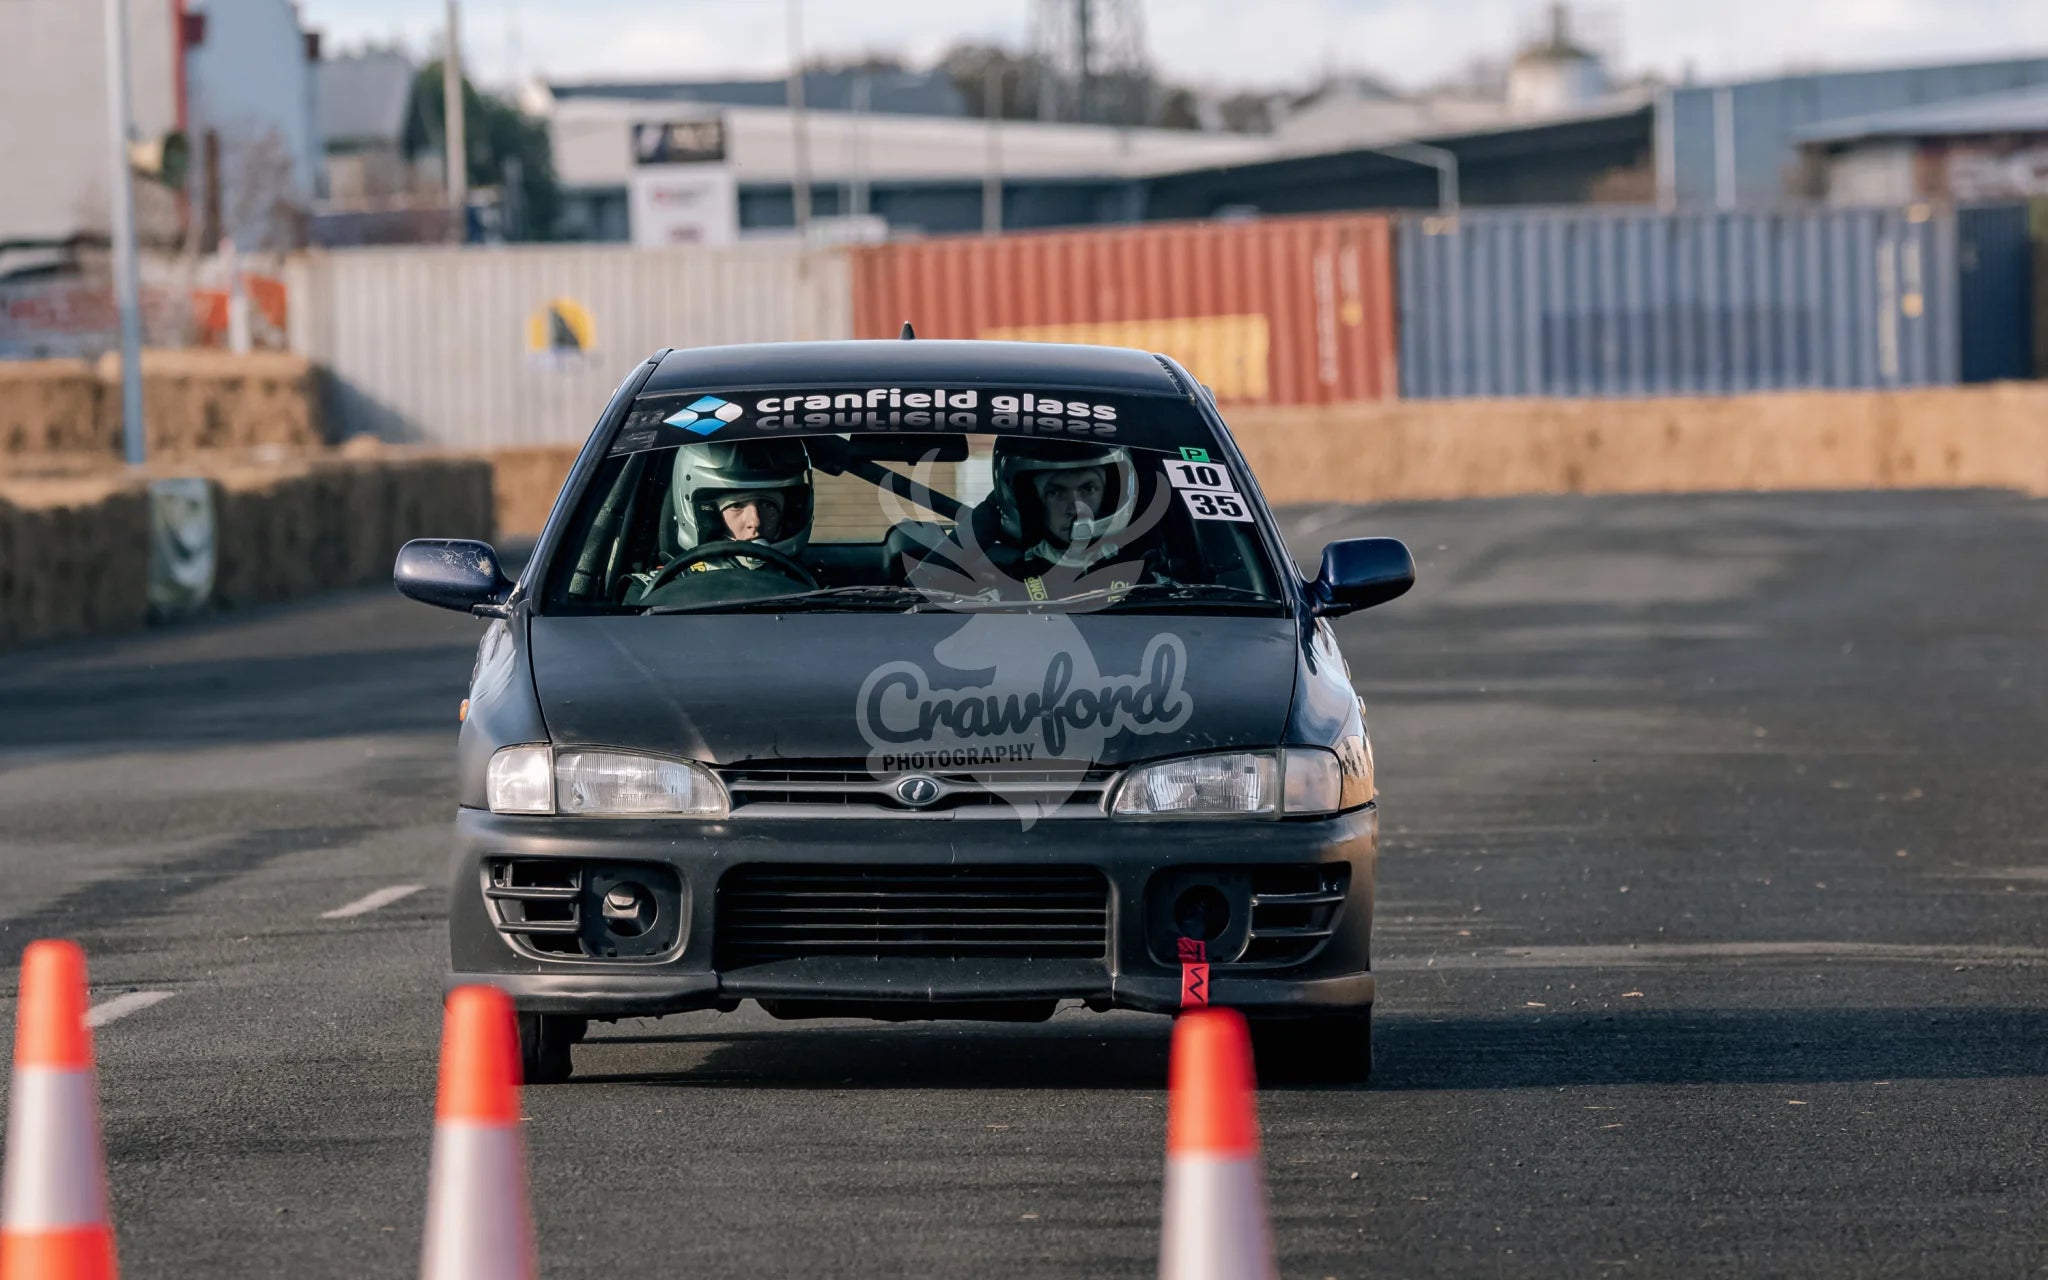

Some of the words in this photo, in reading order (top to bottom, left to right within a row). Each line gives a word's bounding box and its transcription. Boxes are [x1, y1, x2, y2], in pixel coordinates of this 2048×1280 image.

[756, 388, 978, 413] cranfield
[991, 393, 1118, 420] glass
[1184, 448, 1203, 460] P
[1175, 464, 1222, 487] 10
[1190, 494, 1244, 518] 35
